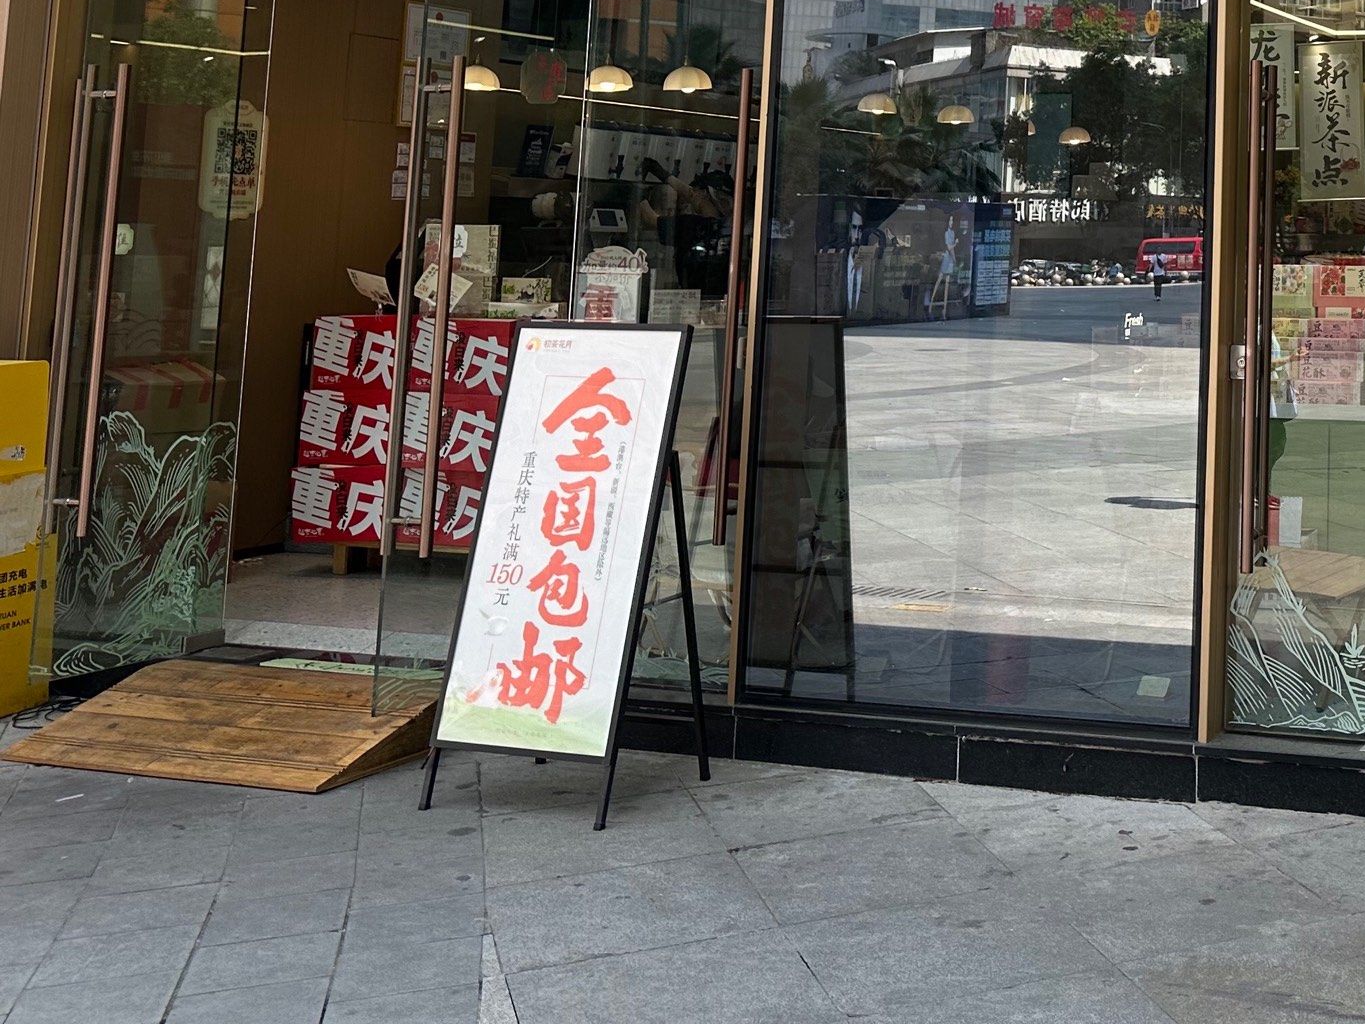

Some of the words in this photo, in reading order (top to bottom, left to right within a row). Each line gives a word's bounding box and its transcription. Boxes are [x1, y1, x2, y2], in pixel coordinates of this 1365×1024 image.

[1312, 52, 1350, 187] 新派茶点
[496, 366, 633, 725] 全国包邮
[11, 618, 31, 629] BANK
